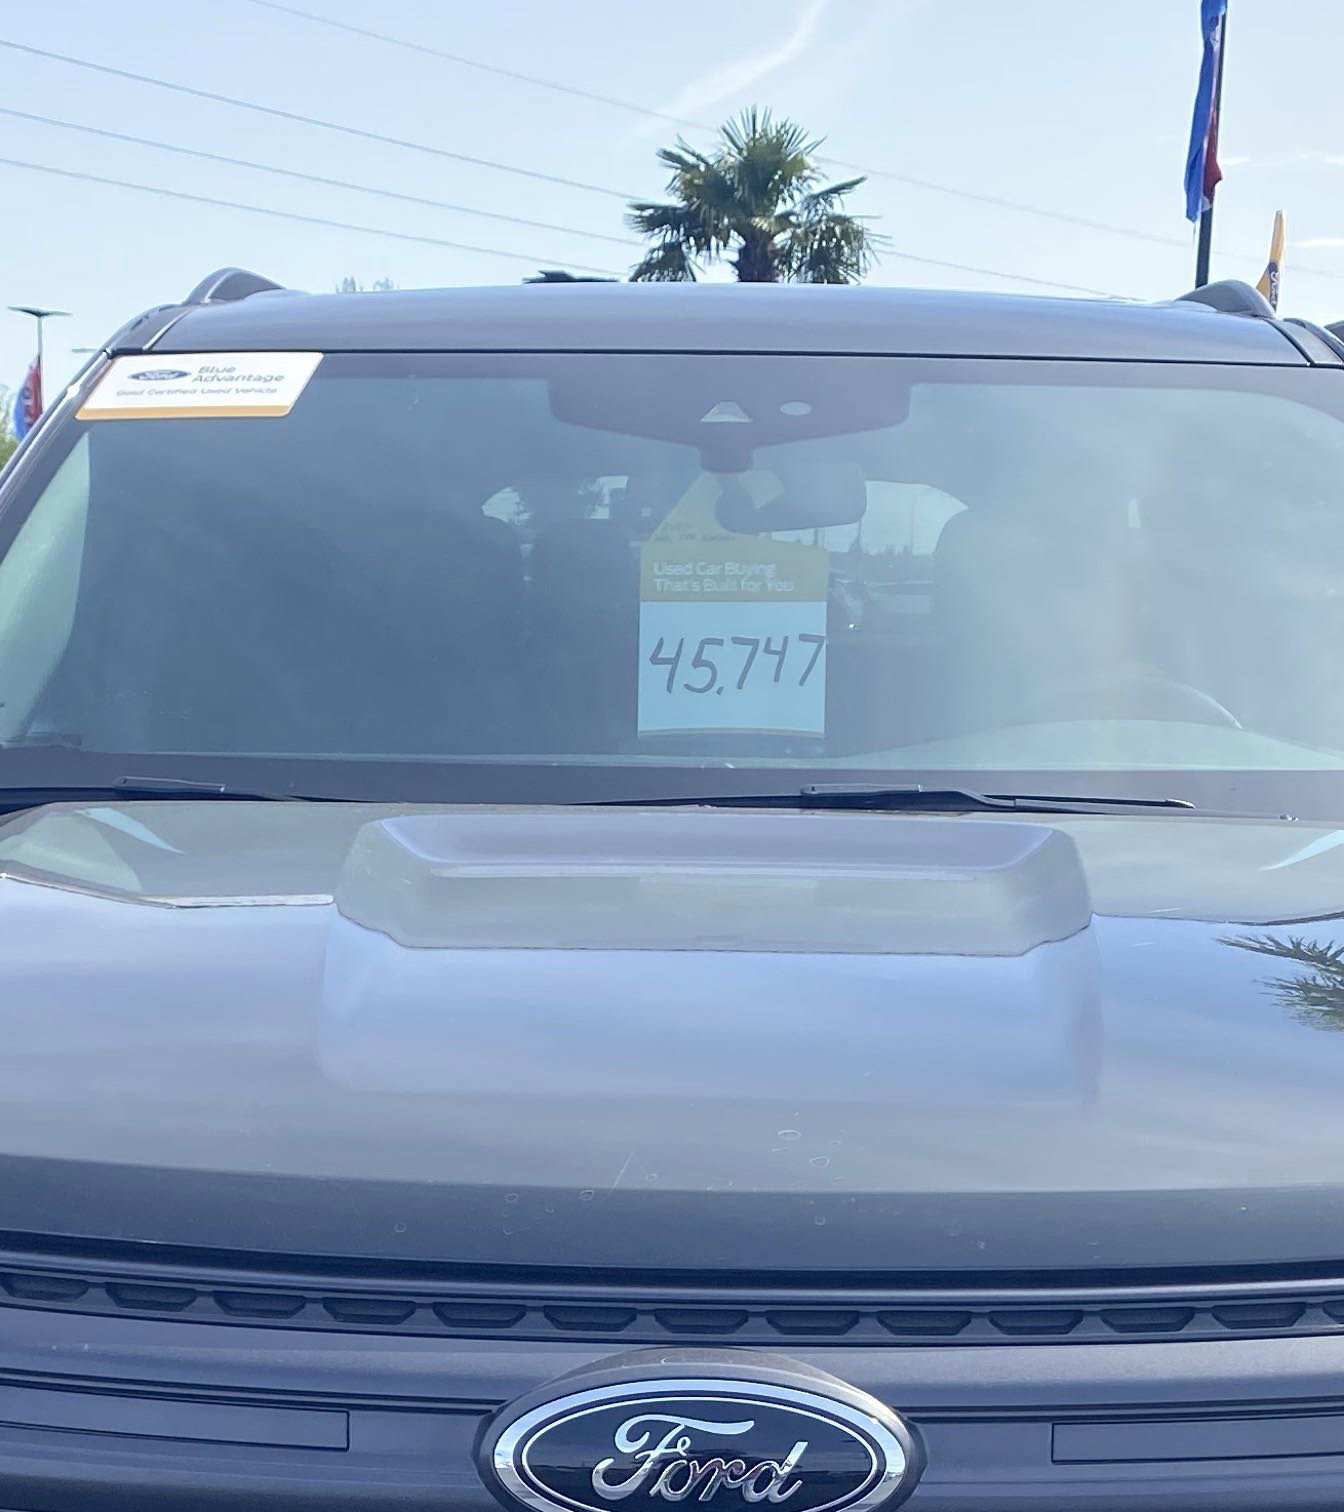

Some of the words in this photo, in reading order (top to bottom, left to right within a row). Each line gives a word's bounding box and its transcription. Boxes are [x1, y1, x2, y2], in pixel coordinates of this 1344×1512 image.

[198, 366, 236, 374] Blue
[192, 374, 285, 383] Advantage
[653, 562, 693, 576] Used
[695, 562, 722, 576] Car
[724, 562, 777, 578] Buying
[655, 578, 700, 592] That's
[703, 578, 739, 592] Built
[740, 578, 763, 592] for
[766, 578, 795, 592] You
[592, 1414, 808, 1502] Ford
